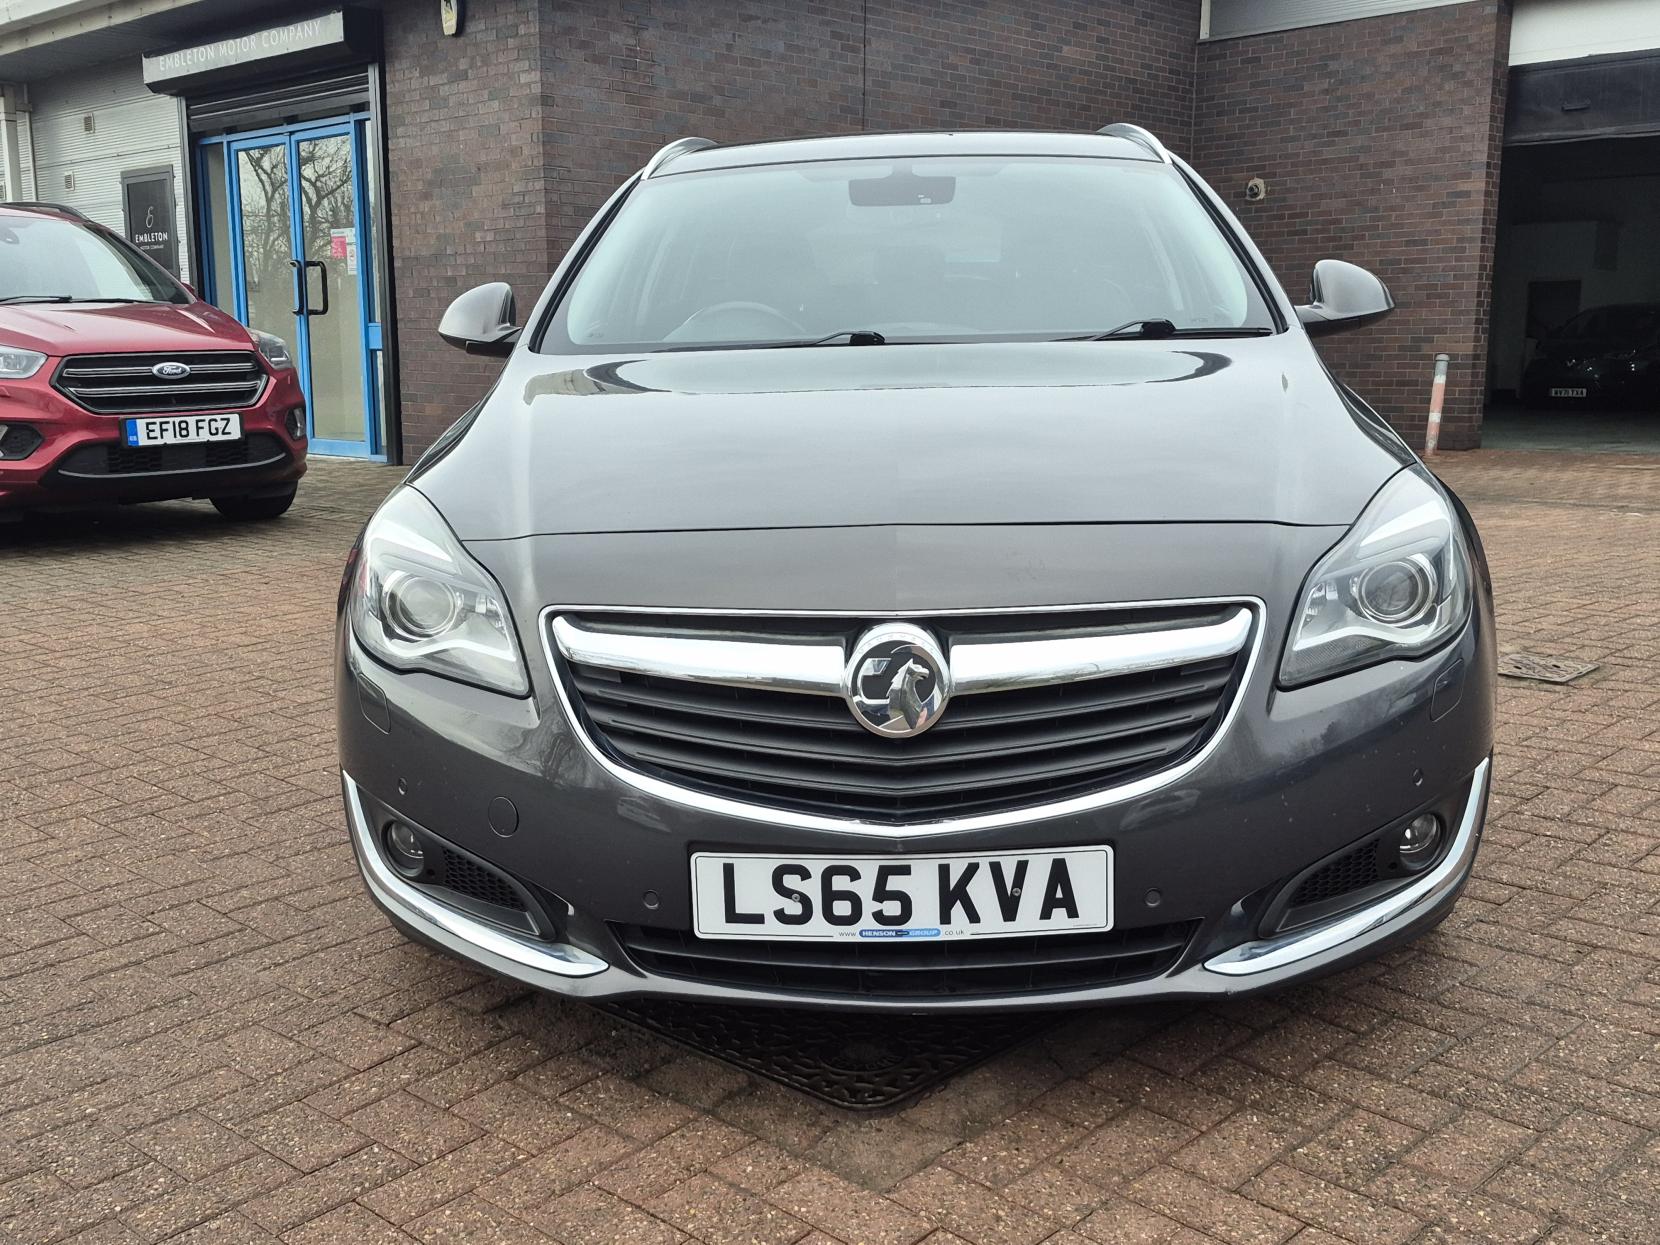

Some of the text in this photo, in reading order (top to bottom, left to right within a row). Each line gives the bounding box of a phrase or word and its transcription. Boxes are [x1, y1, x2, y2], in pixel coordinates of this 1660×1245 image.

[159, 21, 321, 71] EMBLETON MOTOR COMPANY
[135, 231, 168, 243] EMBLETON
[145, 418, 232, 441] EF18 FGZ
[722, 858, 1080, 926] LS65 KVA
[862, 929, 896, 937] HENSON
[908, 929, 939, 937] GROUP
